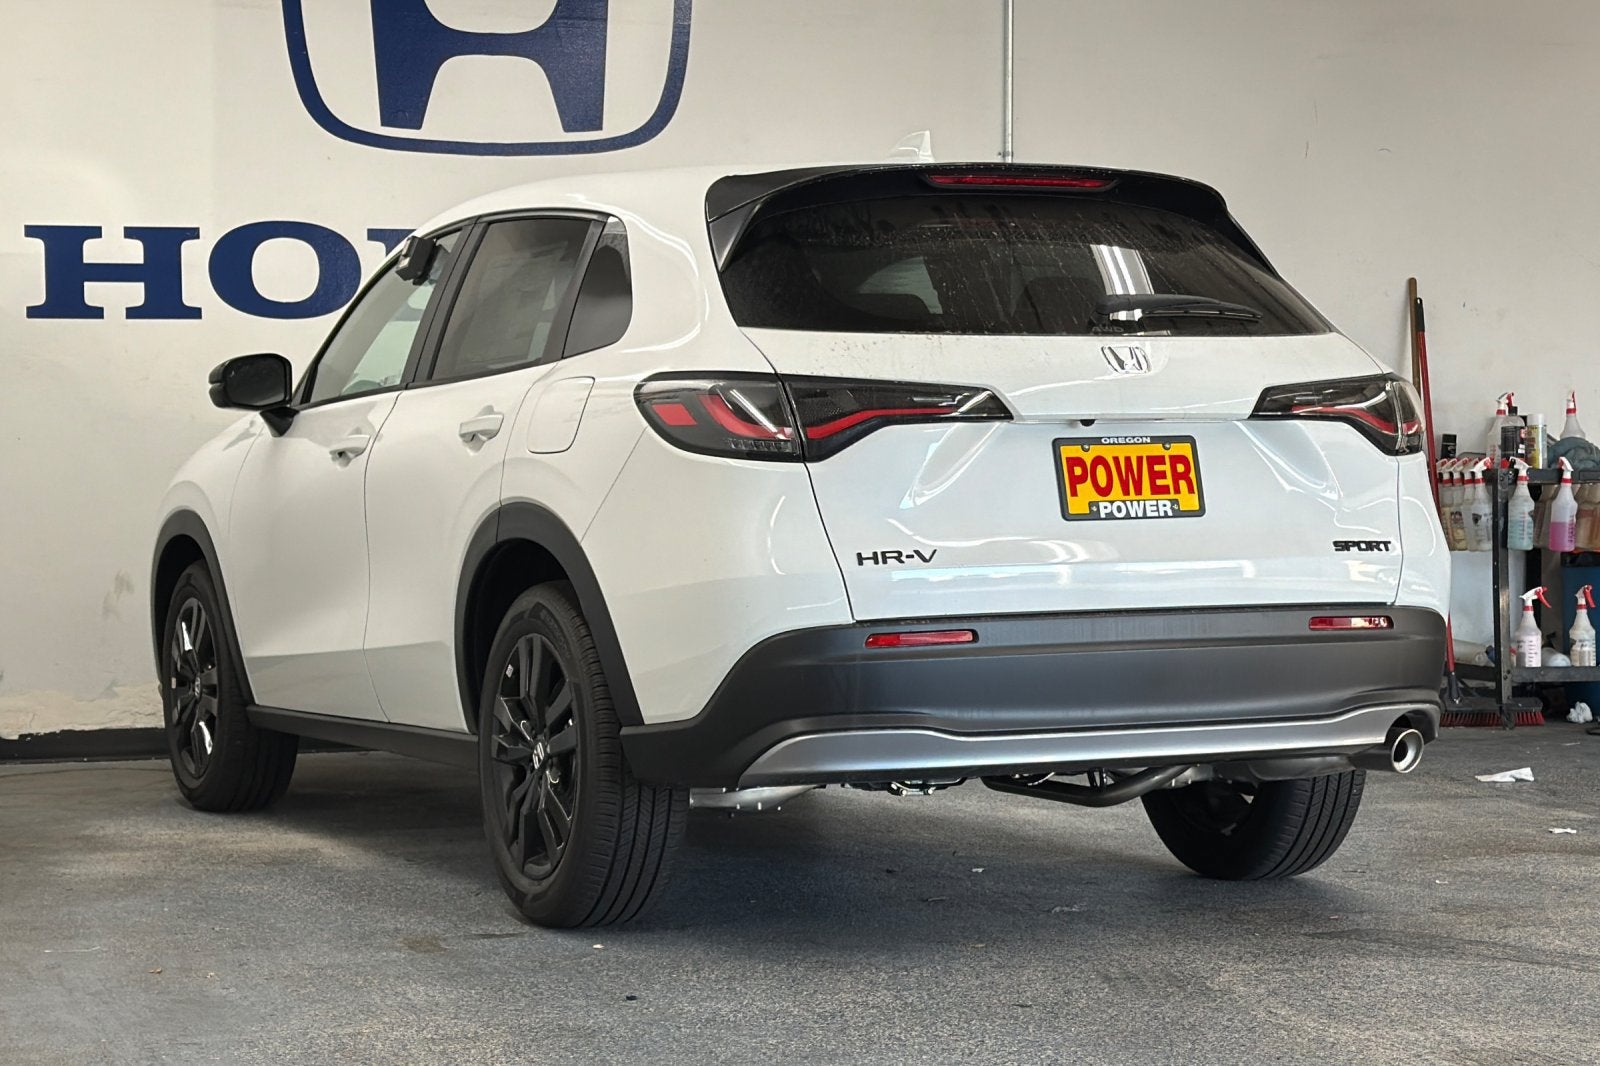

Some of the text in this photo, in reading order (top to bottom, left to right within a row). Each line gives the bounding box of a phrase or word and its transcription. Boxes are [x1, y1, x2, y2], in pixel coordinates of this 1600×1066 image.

[24, 220, 417, 320] HO
[1101, 436, 1151, 444] OREGON
[1065, 454, 1196, 498] POWER
[1098, 500, 1174, 519] POWER
[1332, 540, 1392, 552] SPORT
[856, 548, 938, 567] HR-V
